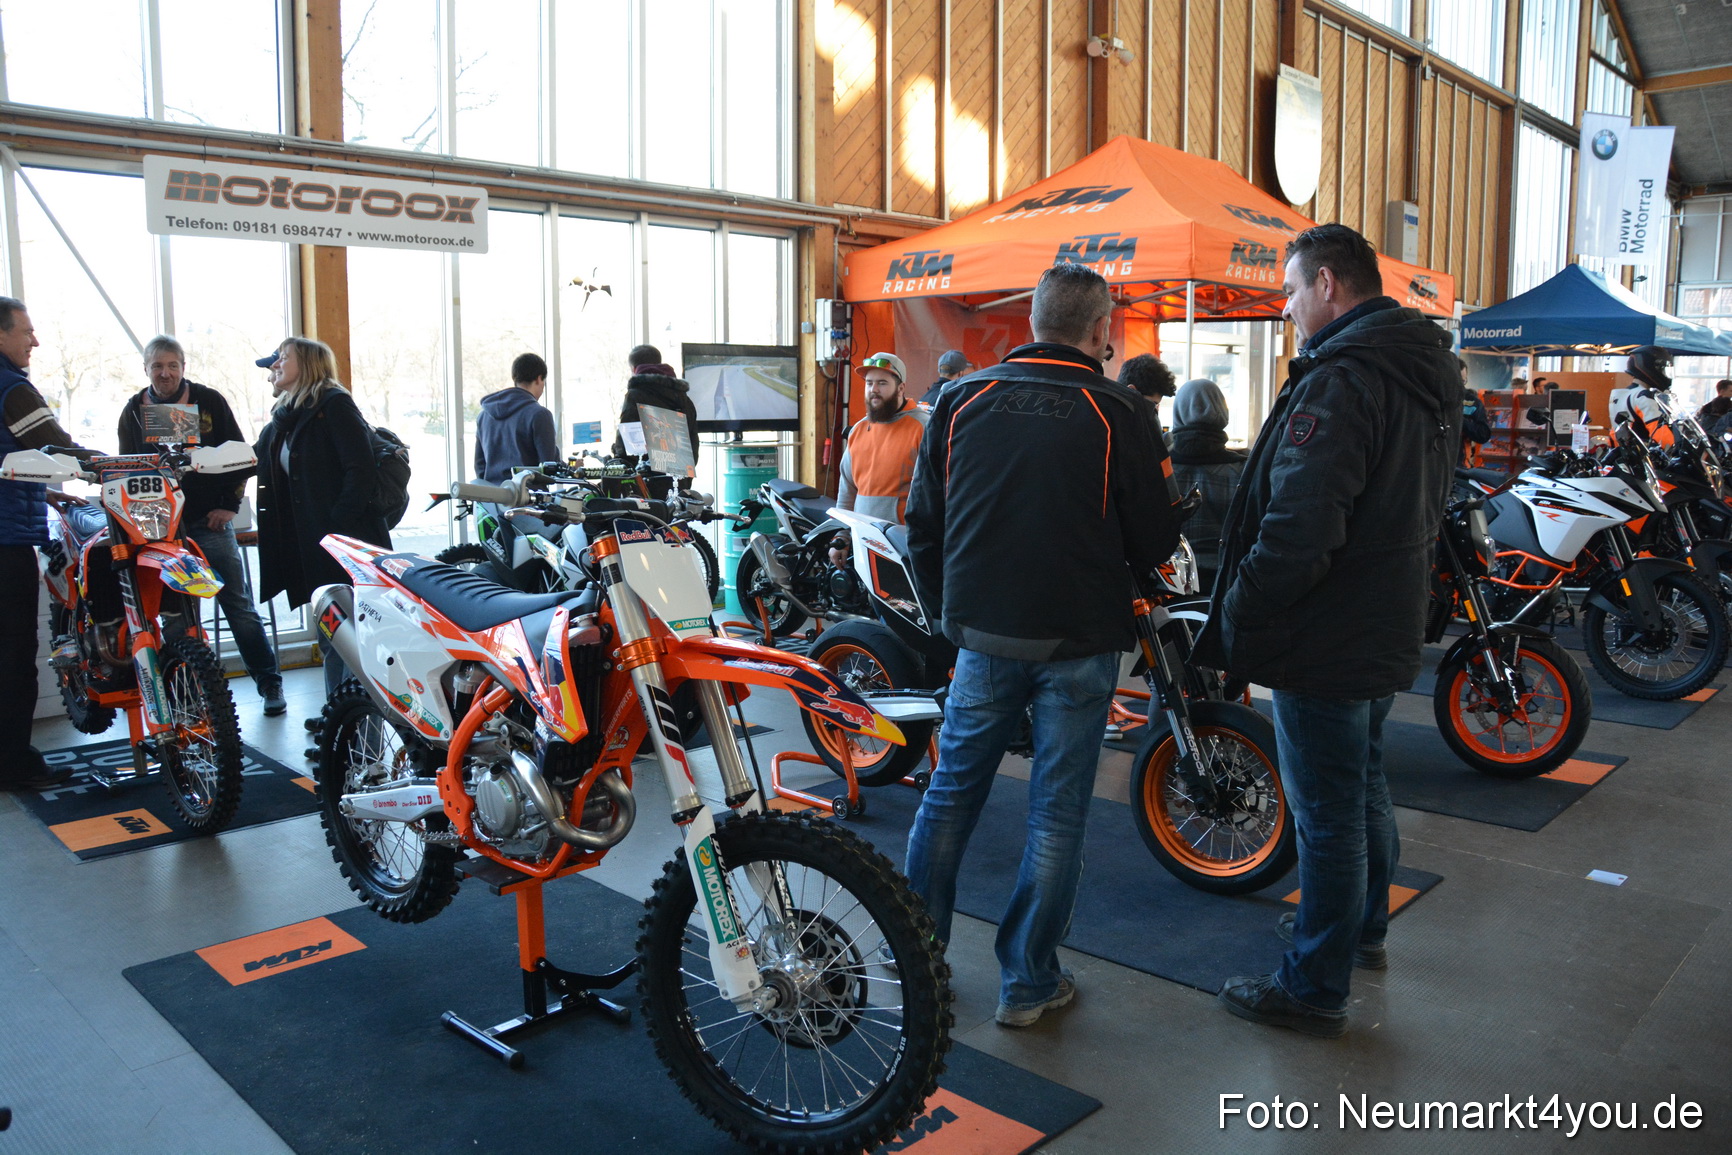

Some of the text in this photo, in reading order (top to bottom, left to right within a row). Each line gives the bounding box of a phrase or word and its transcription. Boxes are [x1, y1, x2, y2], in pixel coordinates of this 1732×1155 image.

[164, 169, 481, 225] motoroox
[1003, 185, 1133, 214] KTM
[165, 215, 475, 248] Telefon: 09181 6984747 www.motoroox.de
[1629, 179, 1654, 254] Motorrad
[1053, 232, 1138, 265] KTM
[1229, 237, 1279, 270] KTM
[886, 250, 955, 282] KTM
[1464, 325, 1523, 340] Motorrad
[989, 389, 1077, 419] KTM
[127, 477, 163, 496] 688
[682, 618, 707, 629] MOTOREX
[113, 816, 151, 835] KTM
[703, 866, 735, 939] MOTOREX
[242, 939, 333, 973] KTM
